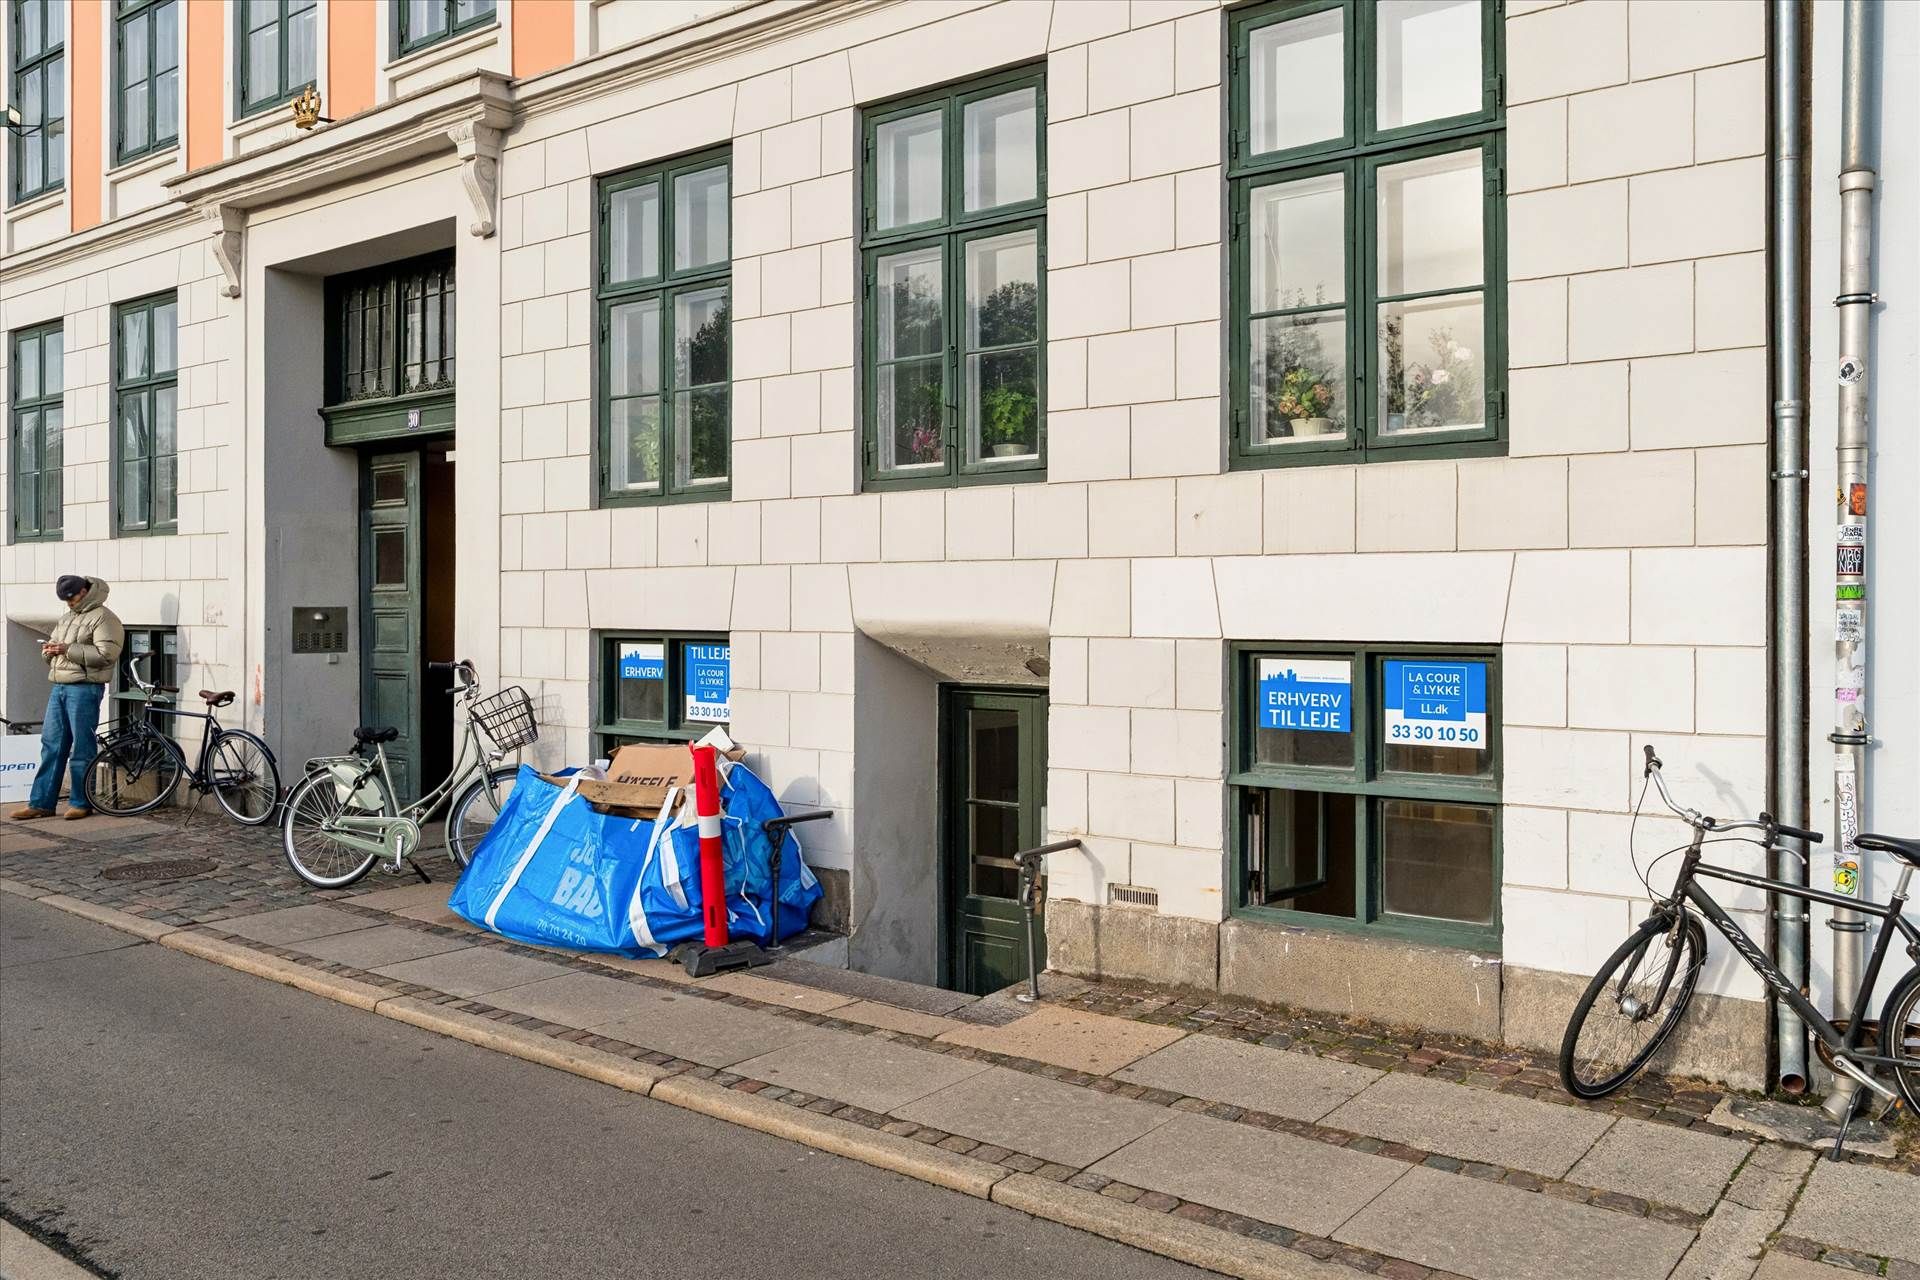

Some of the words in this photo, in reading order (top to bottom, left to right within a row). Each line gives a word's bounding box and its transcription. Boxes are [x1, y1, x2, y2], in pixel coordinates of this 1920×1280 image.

[691, 646, 706, 659] TIL
[625, 667, 663, 678] ERHVERV
[697, 669, 706, 677] LA
[1408, 672, 1424, 683] LA
[1426, 673, 1460, 684] COUR
[699, 677, 704, 685] &
[1412, 684, 1421, 695] &
[1424, 685, 1461, 696] LYKKE
[1268, 691, 1342, 708] ERHVERV
[689, 706, 700, 716] 33
[701, 706, 711, 717] 30
[713, 707, 722, 718] 10
[1421, 703, 1449, 715] LL.dk
[1269, 709, 1297, 727] TIL
[1300, 710, 1341, 729] LEJE
[1392, 724, 1411, 739] 33
[1414, 726, 1433, 740] 30
[1437, 726, 1456, 741] 10
[1459, 727, 1479, 743] 50
